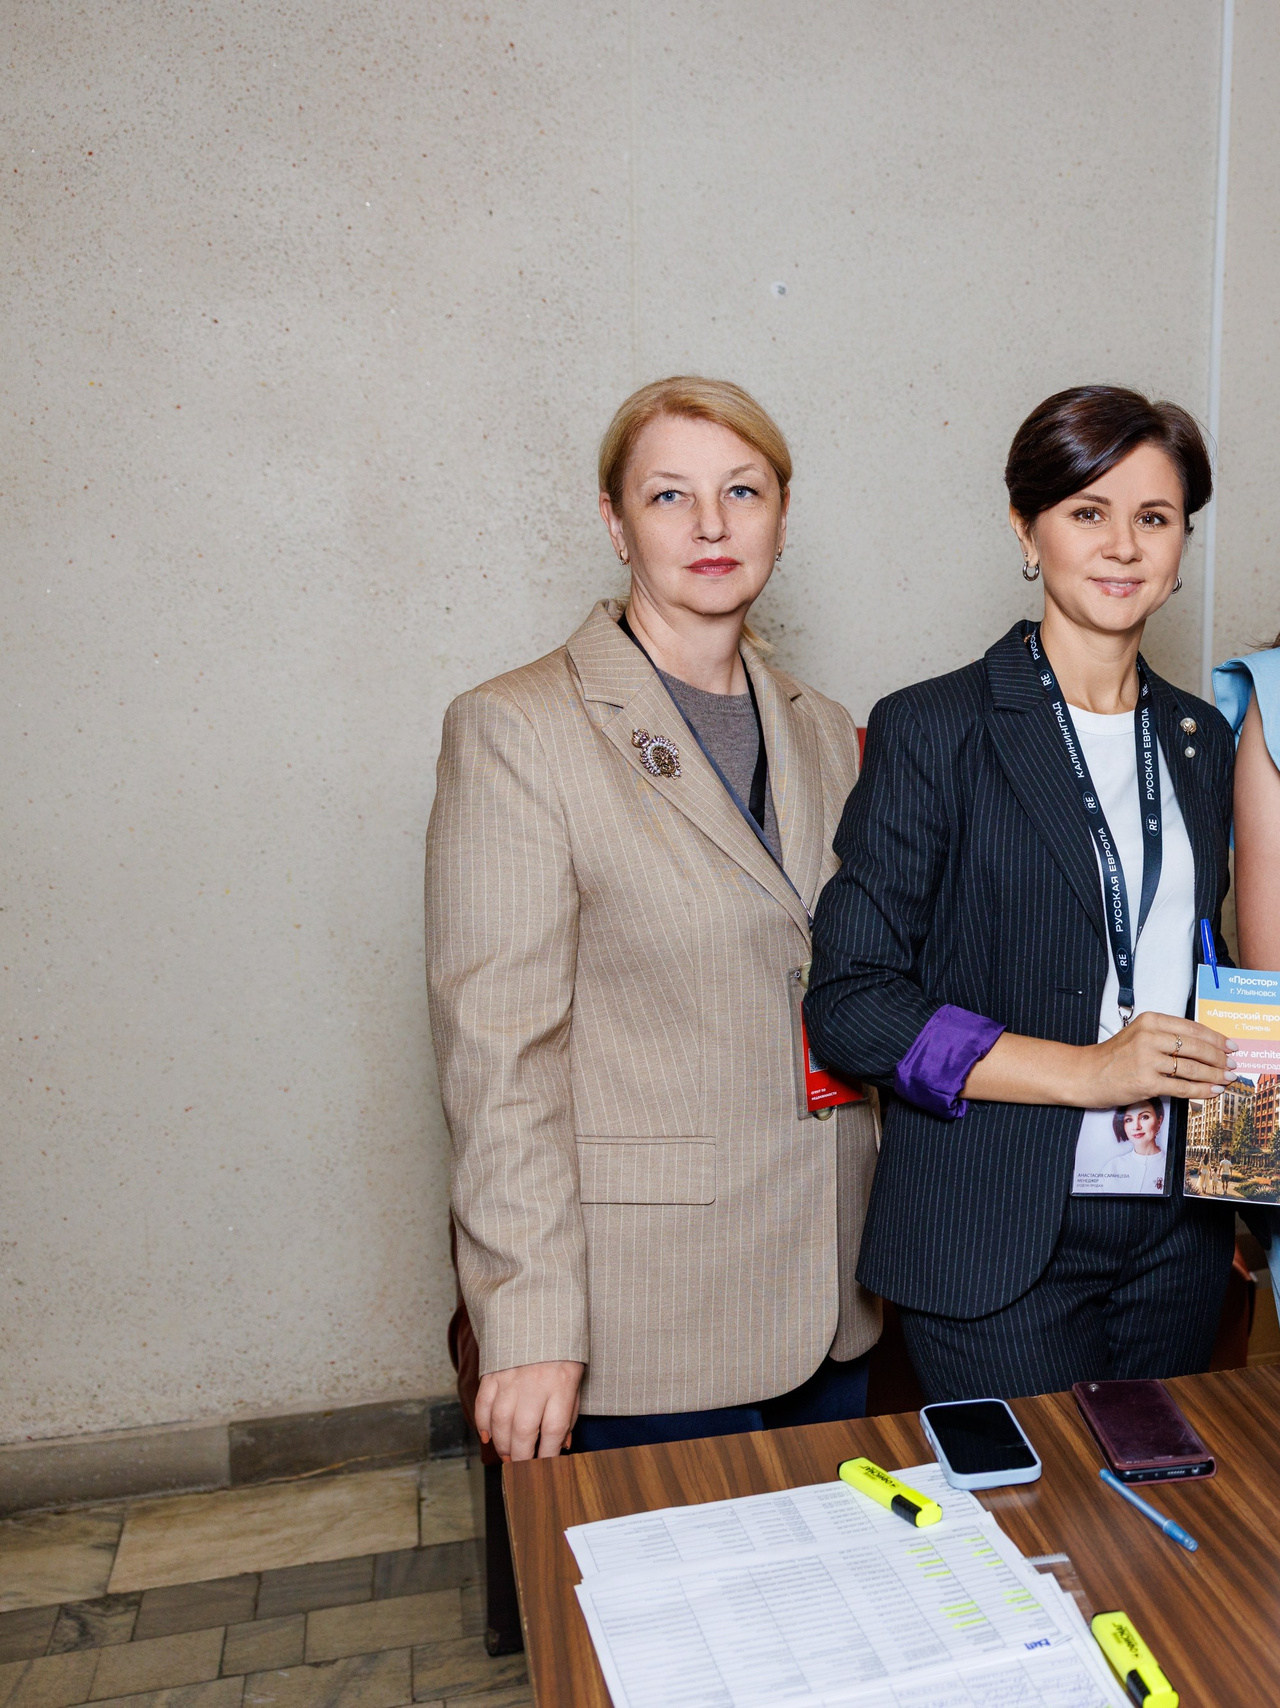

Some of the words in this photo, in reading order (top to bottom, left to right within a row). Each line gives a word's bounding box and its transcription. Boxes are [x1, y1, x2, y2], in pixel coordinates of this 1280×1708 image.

[1141, 707, 1151, 748] ЕВРОПА
[1052, 701, 1085, 779] КАЛИНИНГРАД
[1144, 751, 1155, 800] РУССКАЯ
[1149, 818, 1157, 831] RE
[1097, 827, 1117, 872] ЕВРОПА
[1110, 876, 1124, 933] РУССКАЯ
[1118, 953, 1128, 967] RE
[1228, 975, 1279, 987] «Простор»
[1236, 987, 1277, 997] Ульяновск
[1206, 1008, 1261, 1020] «Авторский
[1241, 1023, 1271, 1032] Тюмень
